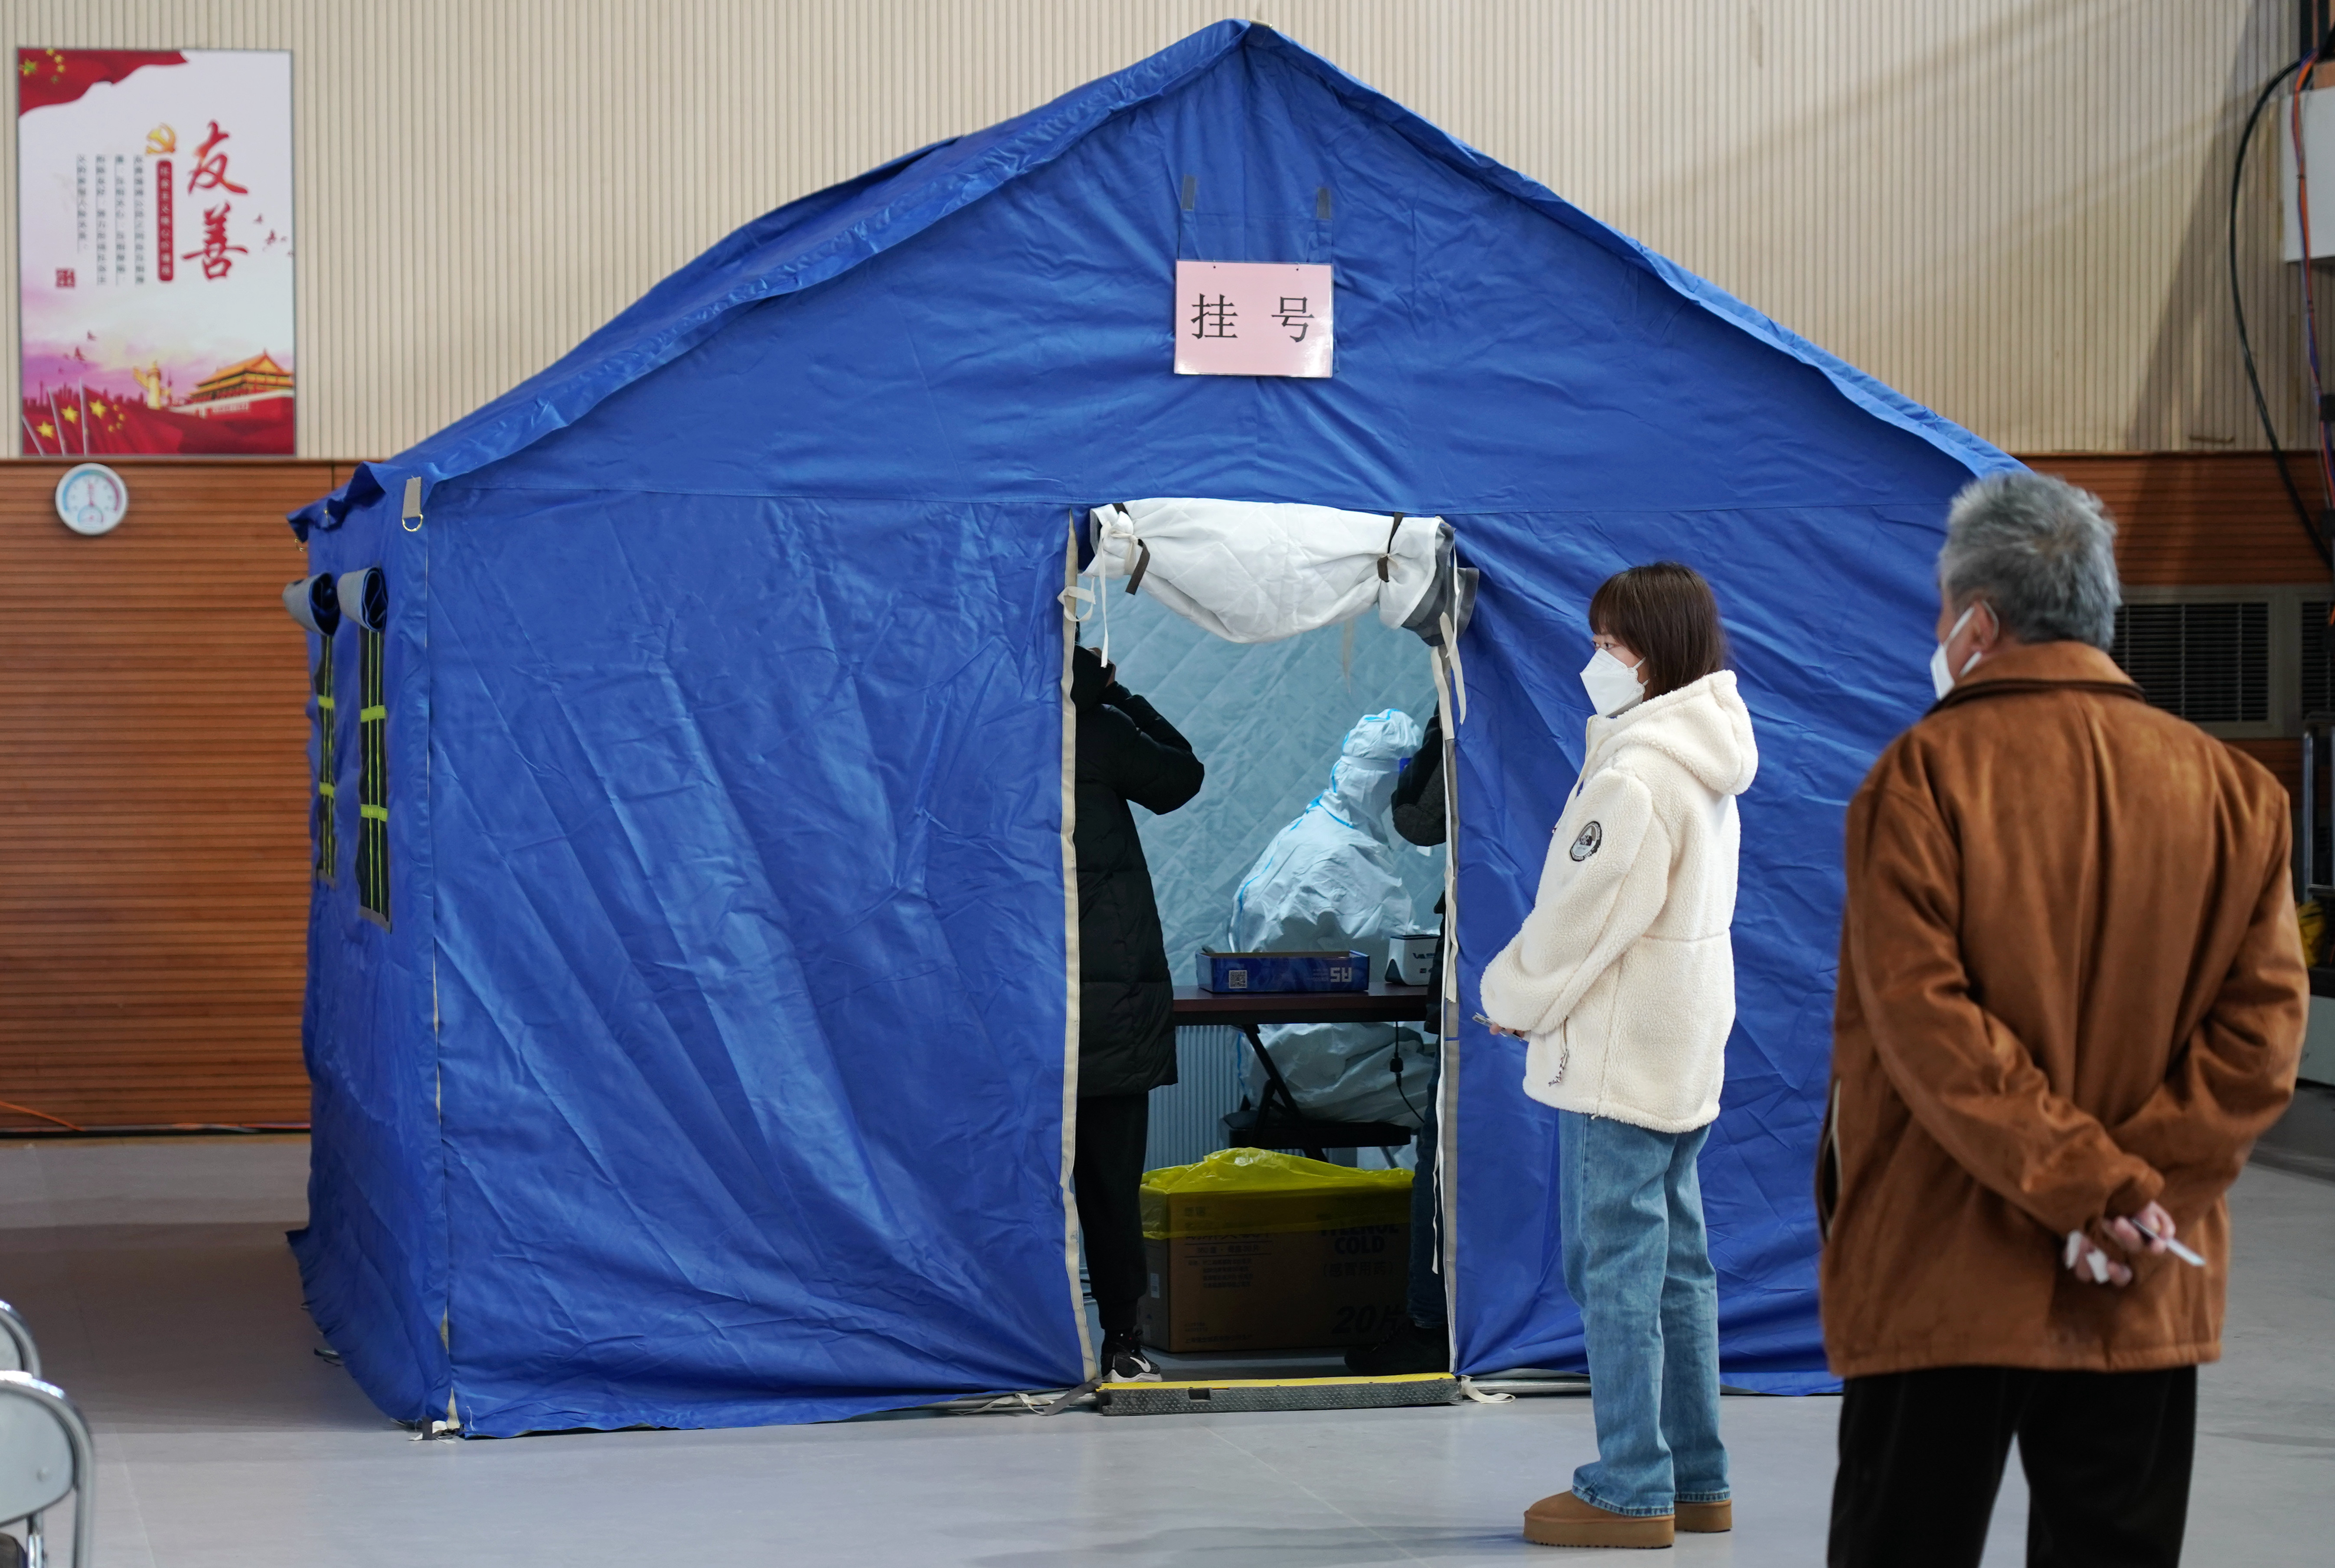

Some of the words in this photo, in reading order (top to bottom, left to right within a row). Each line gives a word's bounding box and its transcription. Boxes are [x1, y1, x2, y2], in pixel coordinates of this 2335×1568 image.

[181, 119, 249, 281] 友善
[1190, 293, 1314, 343] 挂号
[1335, 1235, 1385, 1254] COLD
